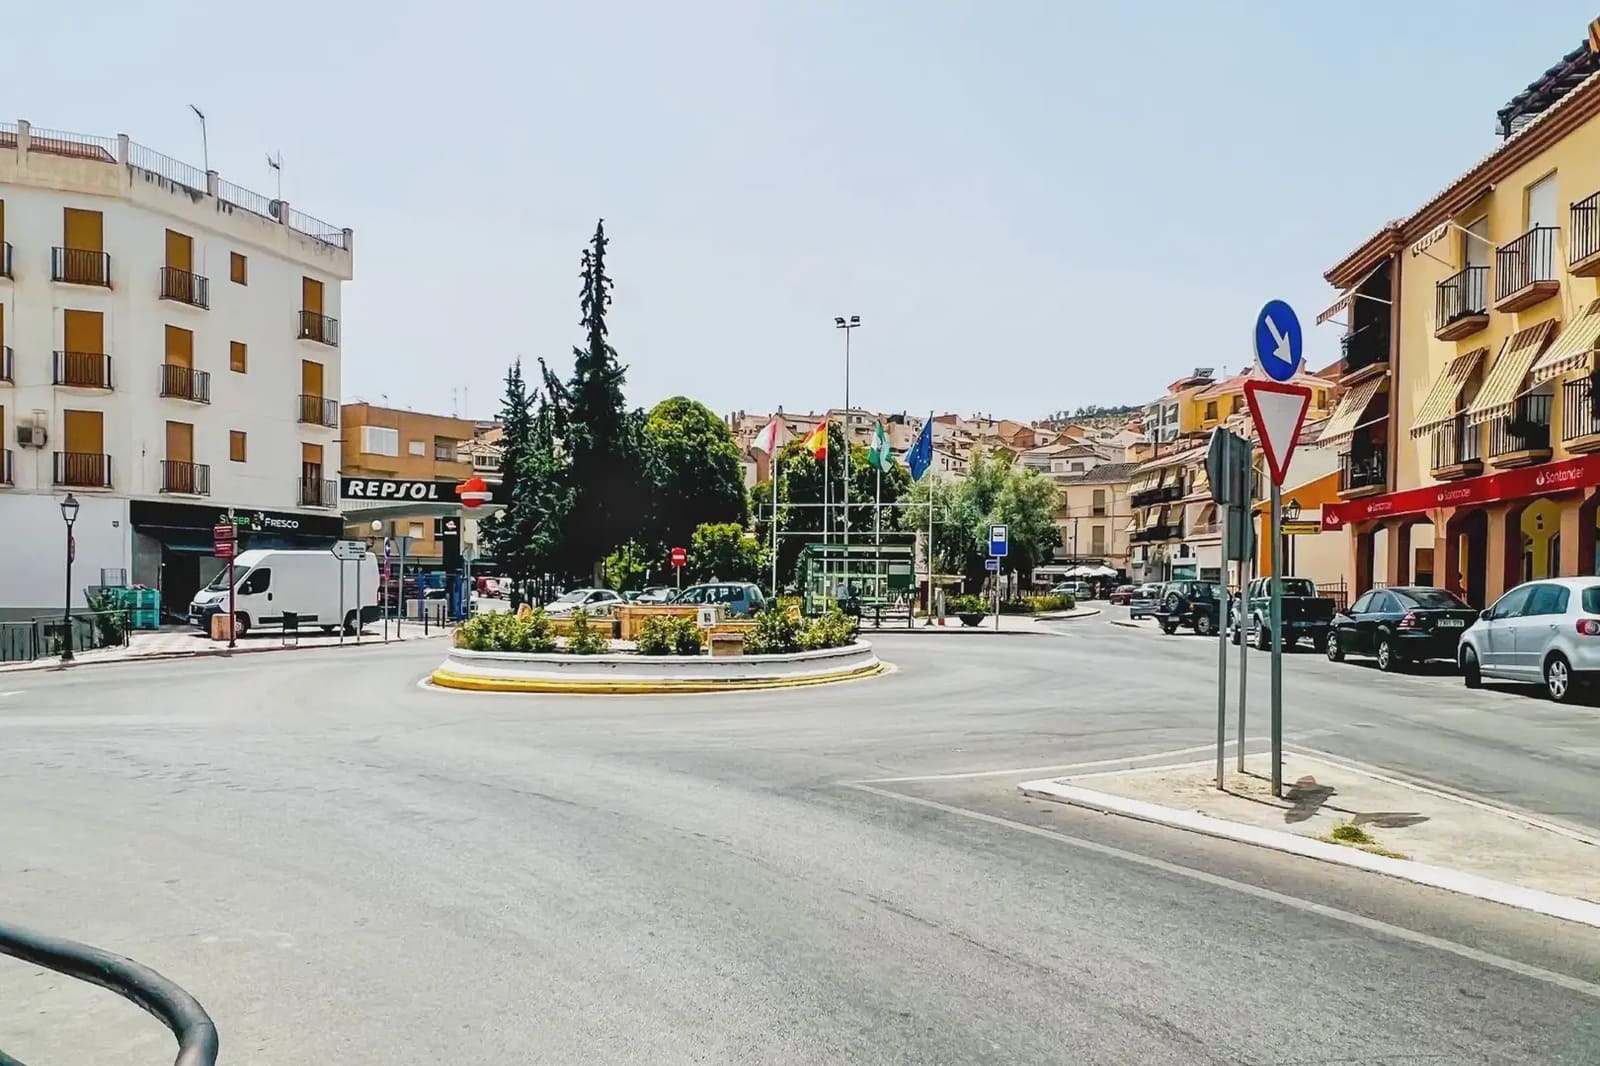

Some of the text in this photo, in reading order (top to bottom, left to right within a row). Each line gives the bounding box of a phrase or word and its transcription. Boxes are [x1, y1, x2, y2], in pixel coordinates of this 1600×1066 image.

[1545, 466, 1584, 484] Santander
[347, 480, 439, 499] REPSOL
[264, 517, 299, 529] FRESCO
